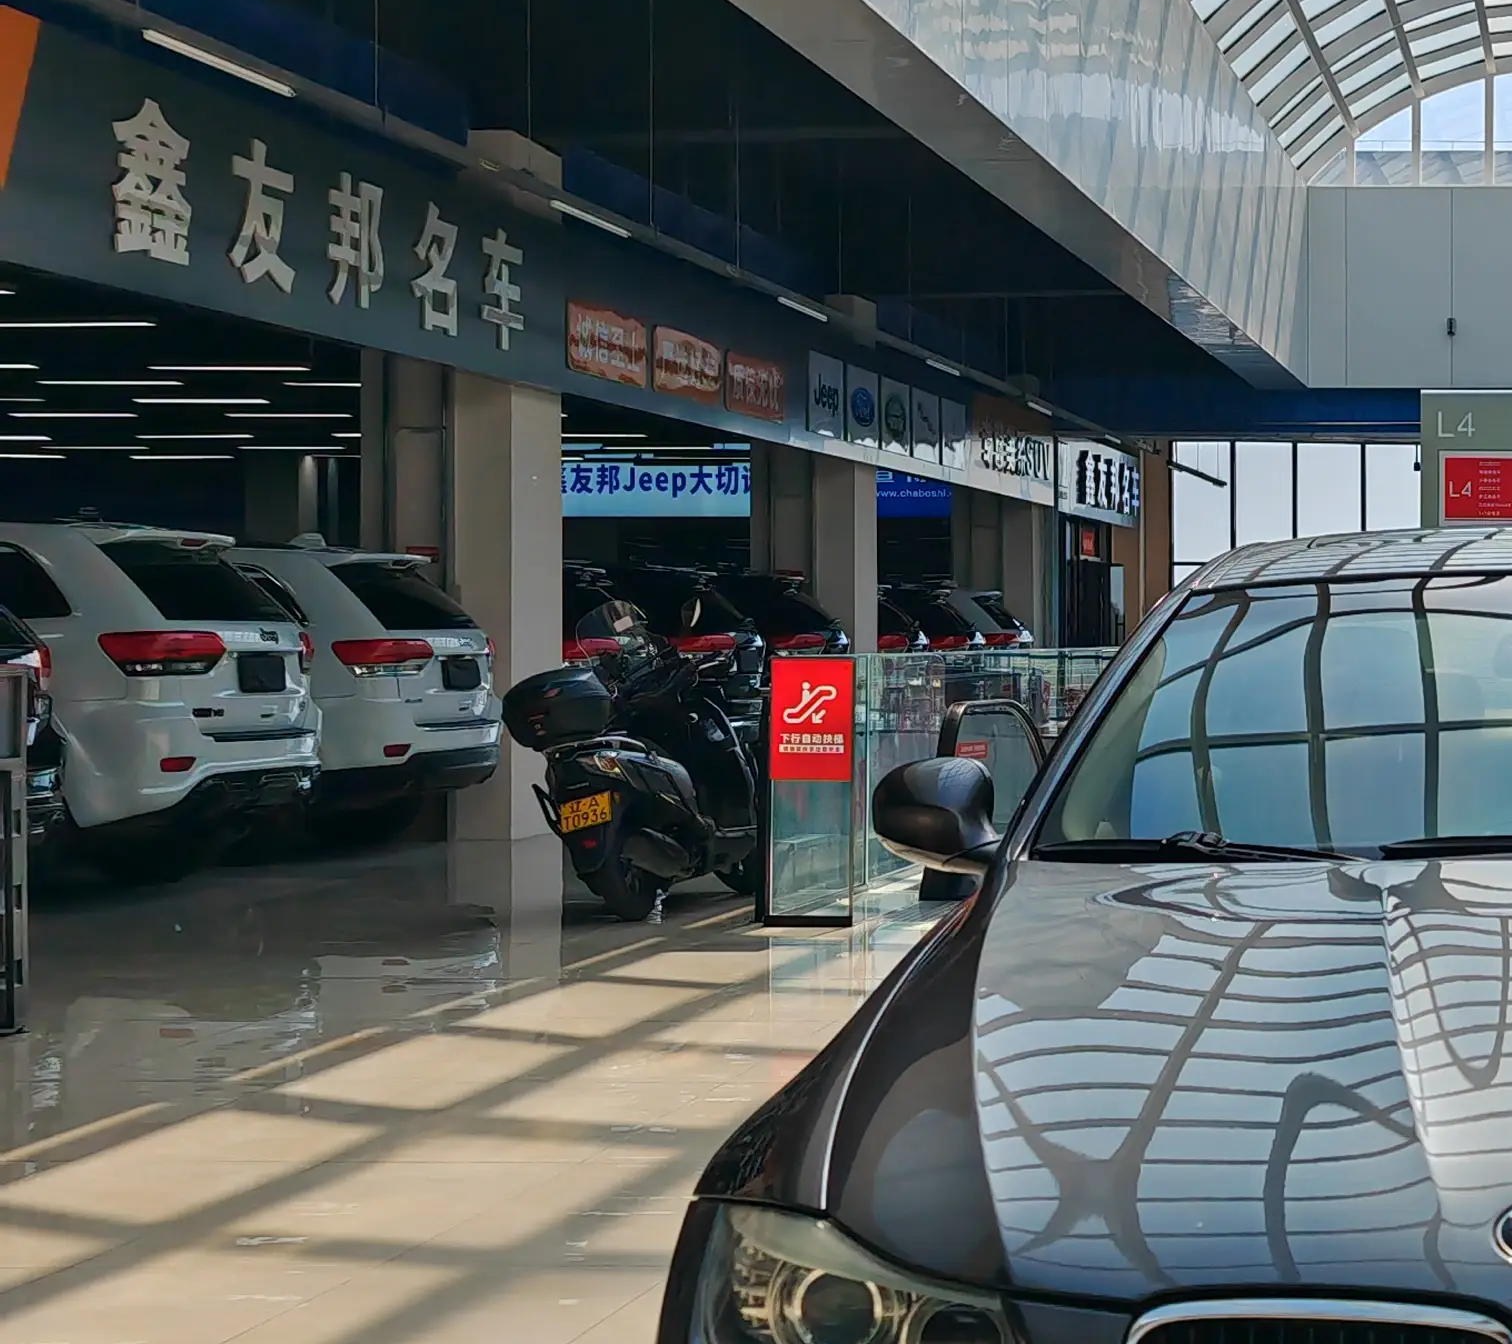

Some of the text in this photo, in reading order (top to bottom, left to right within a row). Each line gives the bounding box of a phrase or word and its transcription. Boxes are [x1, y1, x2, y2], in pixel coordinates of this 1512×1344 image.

[112, 98, 524, 351] 鑫友邦名车
[814, 373, 839, 418] Jeep
[1436, 411, 1476, 438] L4
[562, 464, 751, 498] 友邦Jeep大切
[1449, 481, 1473, 498] L4
[563, 807, 608, 831] T0936
